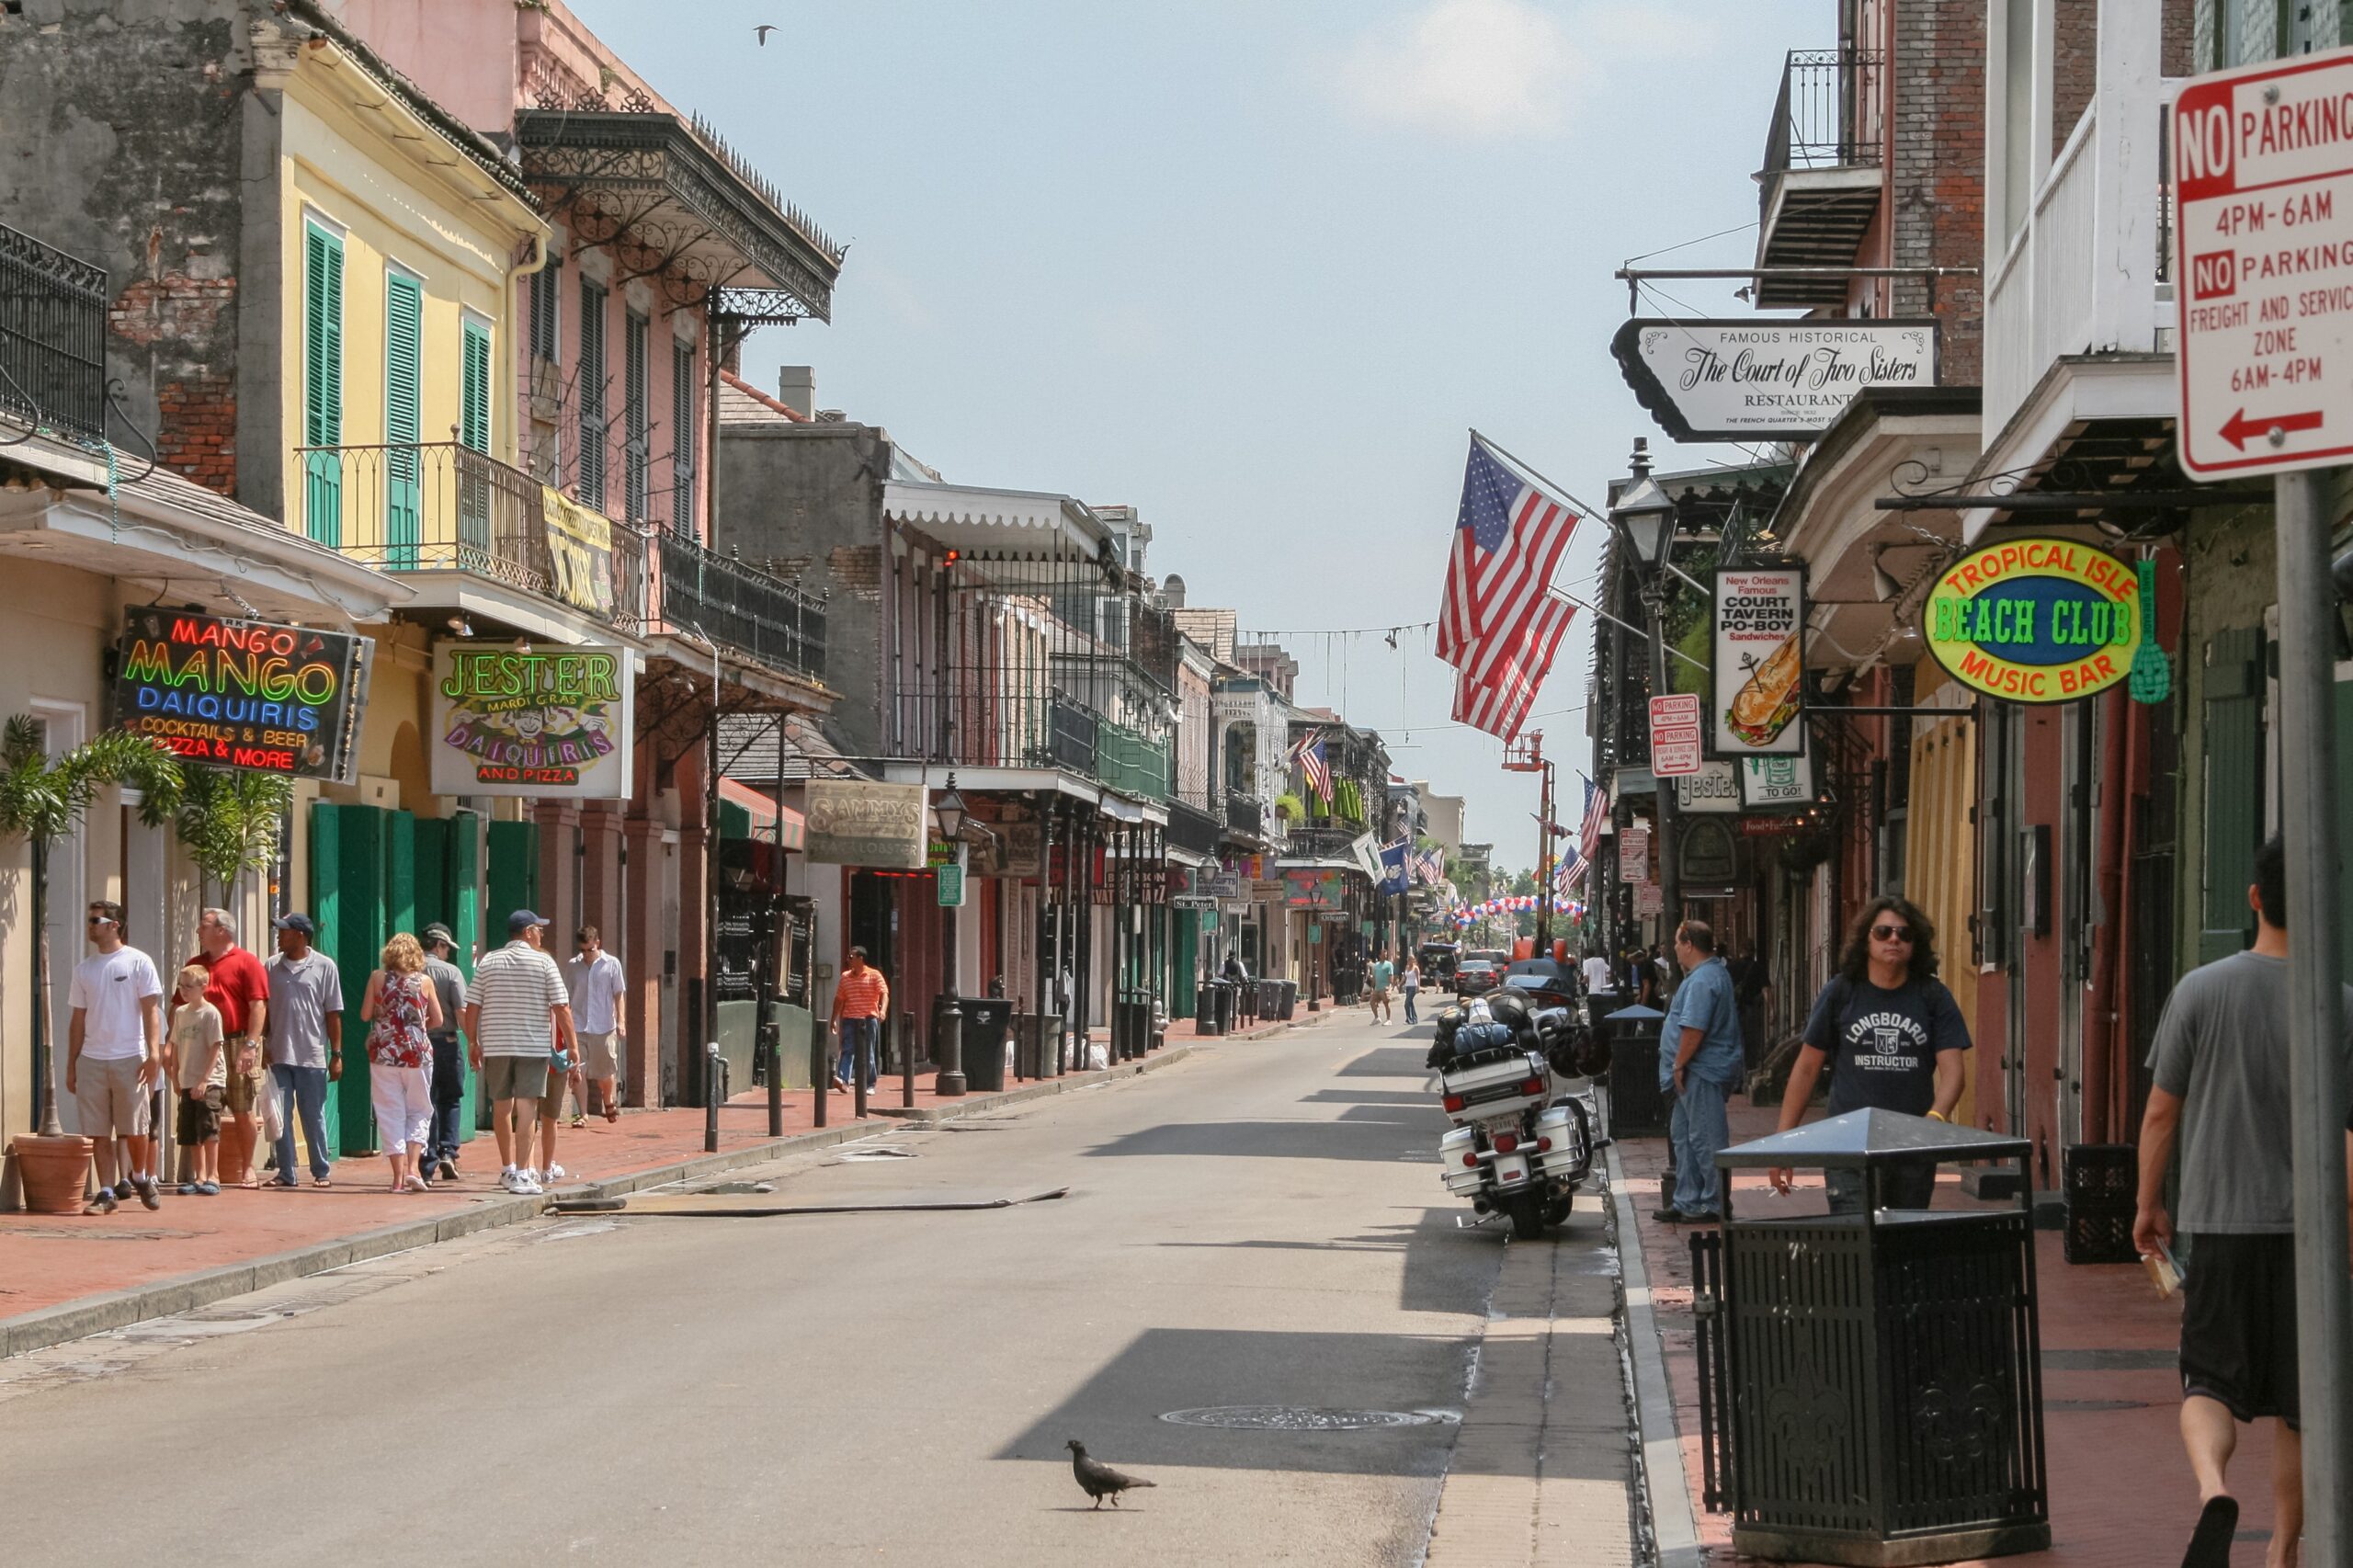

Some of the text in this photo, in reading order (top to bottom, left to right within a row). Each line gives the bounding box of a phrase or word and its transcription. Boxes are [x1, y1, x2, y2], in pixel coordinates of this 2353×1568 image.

[2179, 93, 2353, 182] NO PARKING
[2197, 241, 2353, 292] NO PARKING
[2190, 301, 2249, 333] FREIGHT
[2260, 296, 2289, 322] AND
[1721, 332, 1877, 344] FAMOUS HISTORICAL
[2254, 328, 2297, 357] ZONE
[1680, 346, 1918, 391] The Court of Two Sisters
[1745, 393, 1854, 406] RESTAURANT
[1725, 576, 1790, 585] New Orleans
[1945, 544, 2138, 602] TROPICAL ISLE
[1724, 597, 1790, 608] COURT
[1737, 586, 1777, 595] Famous
[1721, 620, 1794, 631] PO-BOY
[1722, 608, 1794, 619] TAVERN
[1934, 597, 2131, 646] BEACH CLUB
[171, 619, 295, 656] MANGO
[1729, 631, 1786, 641] Sandwiches
[126, 640, 336, 705] MANGO
[441, 650, 621, 701] JESTER
[1959, 651, 2117, 696] MUSIC BAR
[139, 687, 319, 731] DAIQUIRIS
[488, 694, 578, 712] MARDI GRAS
[1653, 699, 1693, 712] NO PARKING
[141, 716, 308, 747] COCKTAILS & BEER
[1654, 730, 1695, 742] NO PARKING
[153, 736, 294, 769] PIZZA & MORE
[448, 728, 612, 767] DAIQUIRIS
[479, 768, 574, 781] AND PIZZA
[1782, 787, 1802, 797] GO!
[1846, 1012, 1927, 1045] LONGBOARD
[1855, 1054, 1918, 1067] INSTRUCTOR
